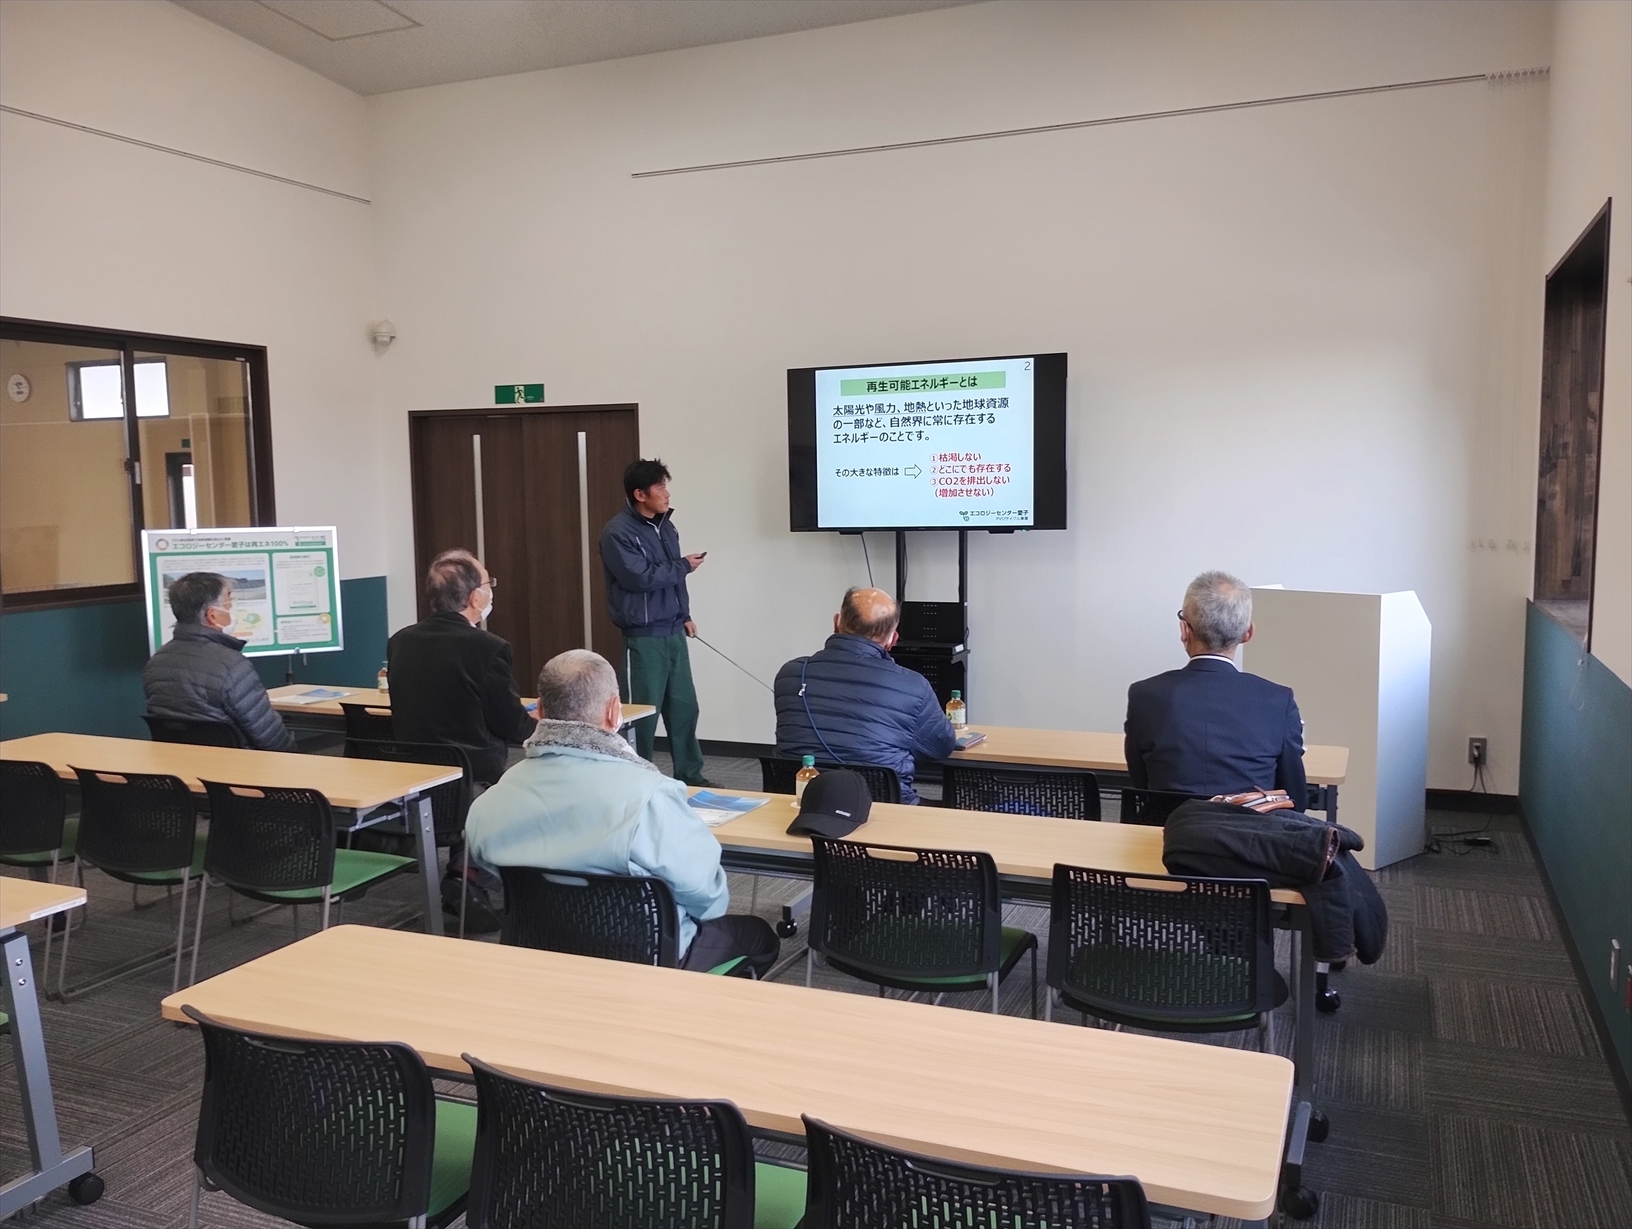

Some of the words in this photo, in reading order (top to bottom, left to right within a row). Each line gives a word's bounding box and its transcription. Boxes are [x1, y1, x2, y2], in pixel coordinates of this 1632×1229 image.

[1024, 361, 1031, 371] 2
[866, 376, 978, 392] 再生可能エネルギーとは
[832, 397, 1009, 416] 太陽光や風力、地熱といった地球資源
[833, 413, 996, 430] の一部など、自然界に常に存在する
[833, 430, 930, 444] エネルギーのことです。
[835, 467, 900, 477] その大きな特徴は
